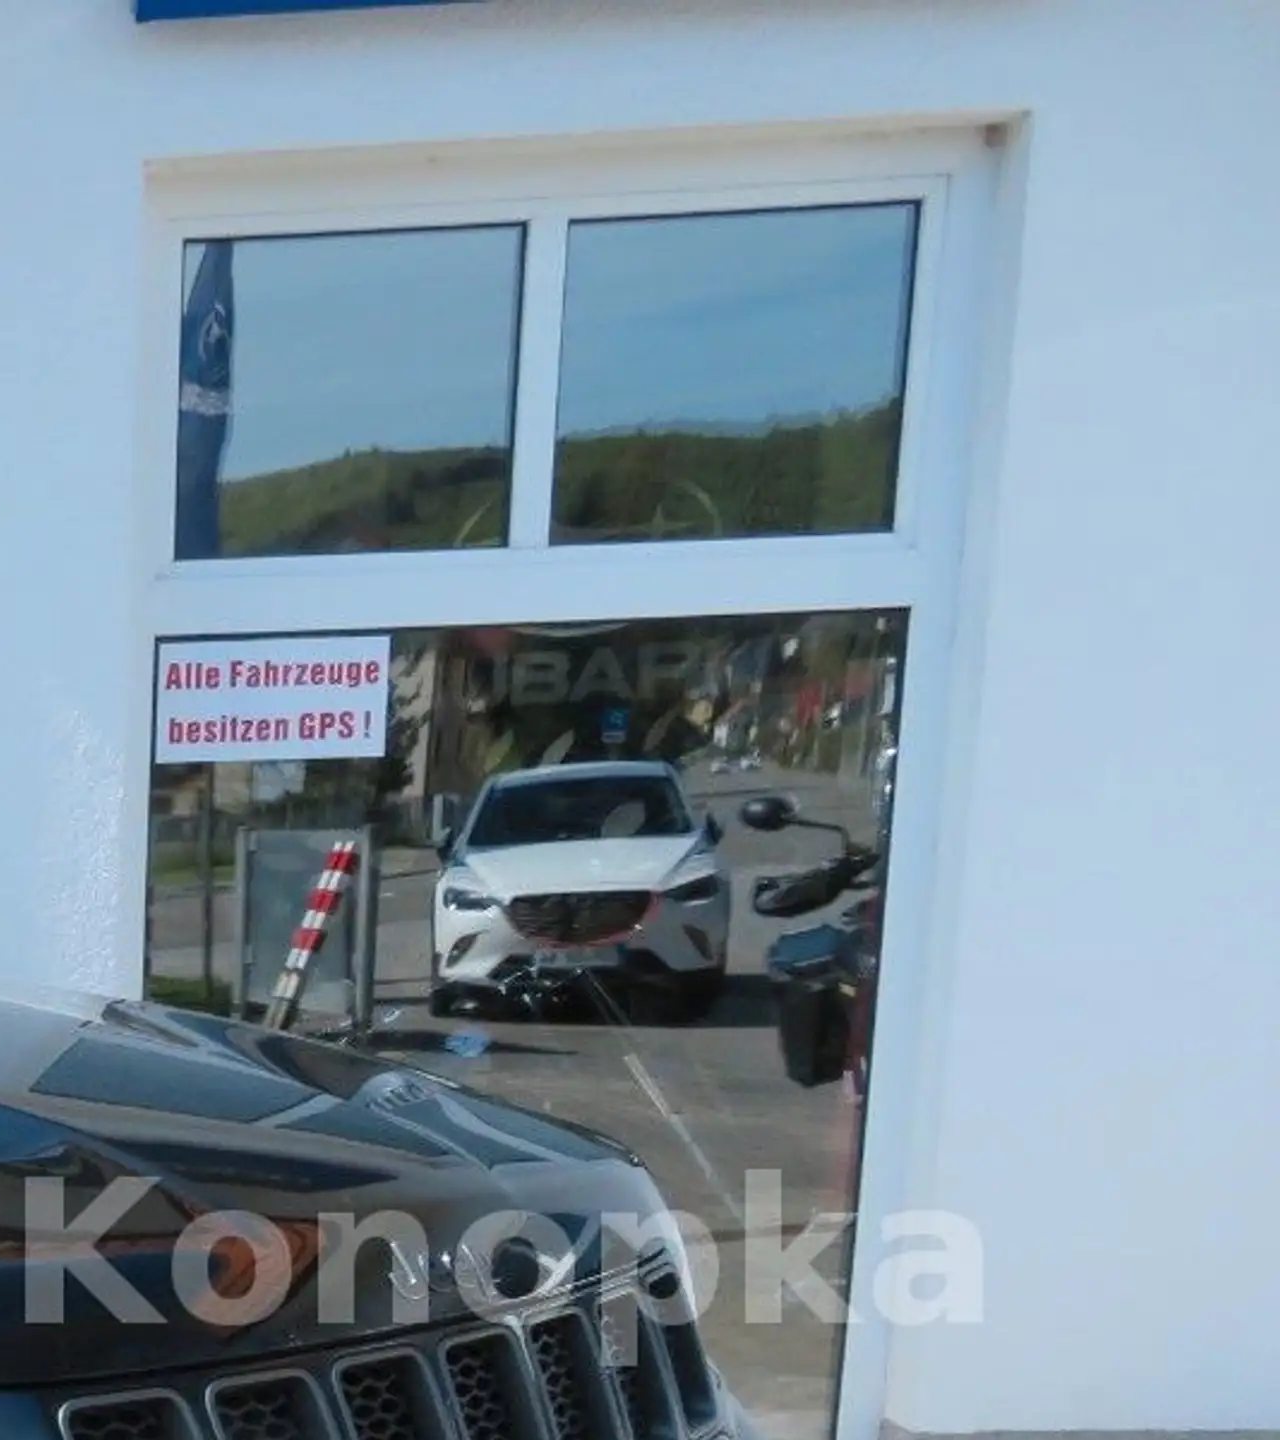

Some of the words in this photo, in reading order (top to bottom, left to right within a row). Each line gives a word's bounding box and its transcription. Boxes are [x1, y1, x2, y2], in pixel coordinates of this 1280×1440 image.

[165, 662, 221, 690] Alle
[230, 659, 380, 688] Fahrzeuge
[168, 714, 289, 744] besitzen
